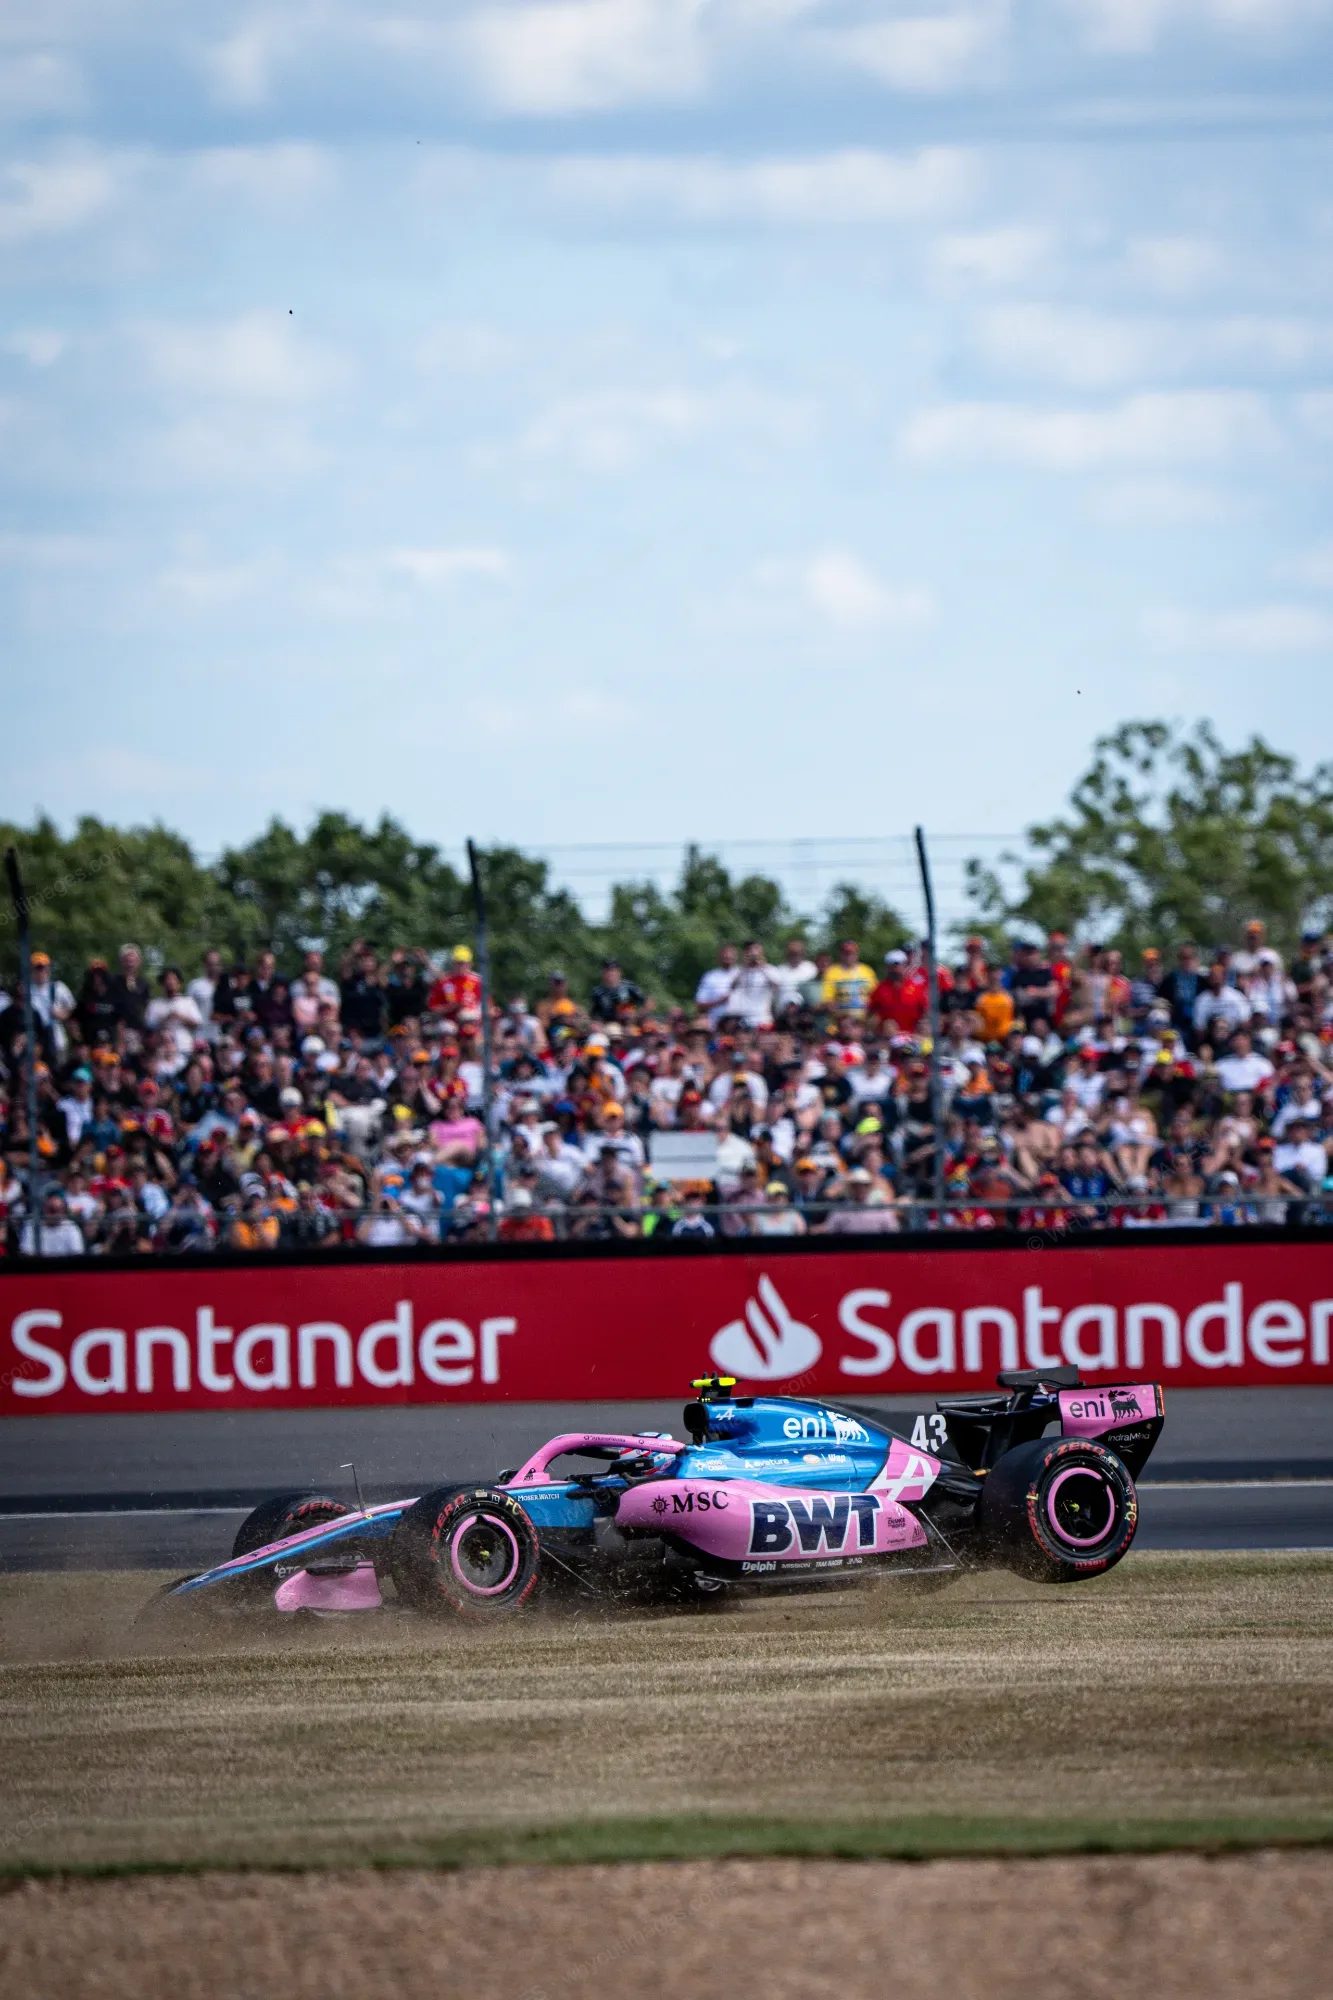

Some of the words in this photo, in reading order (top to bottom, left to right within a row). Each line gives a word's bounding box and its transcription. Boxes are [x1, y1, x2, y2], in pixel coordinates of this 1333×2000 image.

[838, 1281, 1333, 1376] Santander
[11, 1301, 516, 1397] Santander
[1069, 1394, 1105, 1419] eni
[783, 1411, 827, 1439] eni
[910, 1414, 948, 1452] 43
[1107, 1431, 1150, 1442] IndraMind
[1057, 1442, 1105, 1456] ZERO
[298, 1501, 347, 1516] ZERO
[672, 1490, 729, 1514] MSC
[746, 1493, 883, 1557] BWT
[742, 1561, 777, 1572] Delphi
